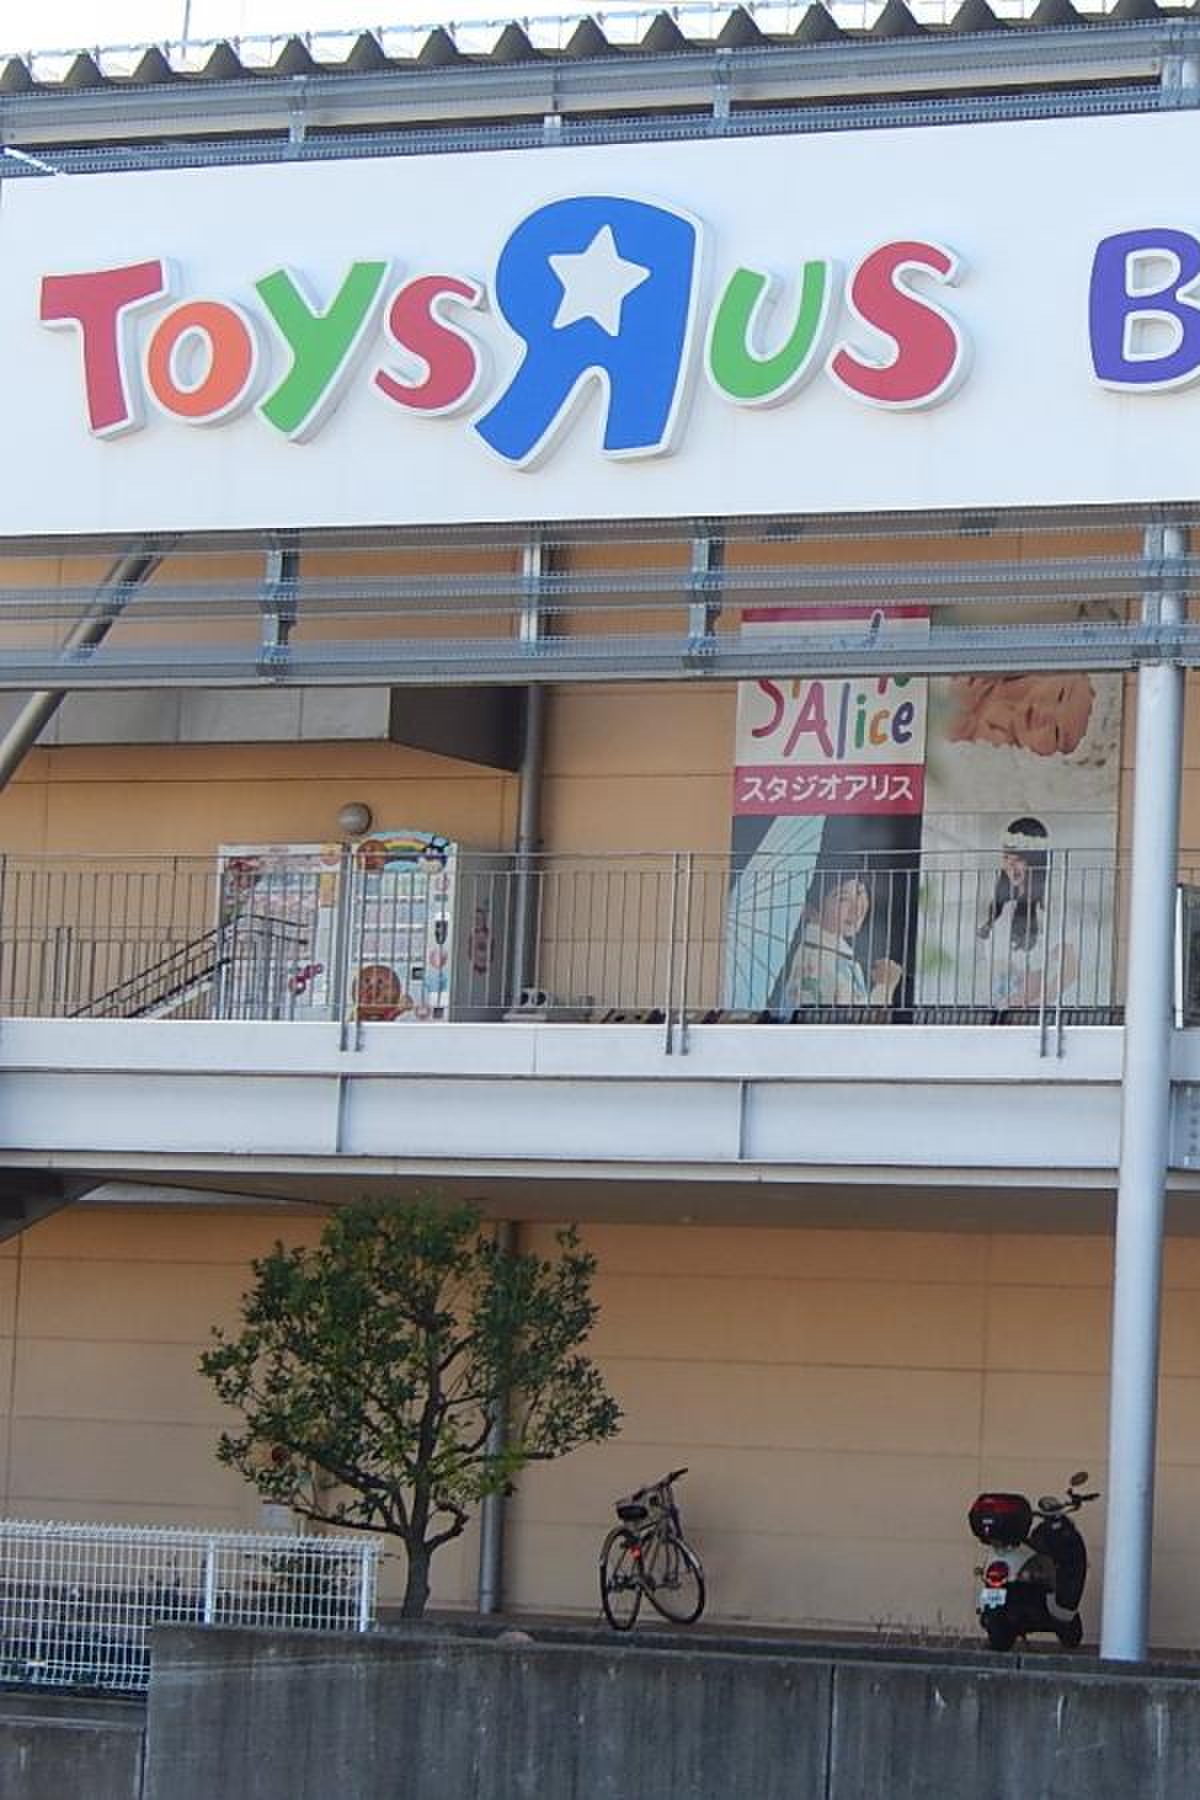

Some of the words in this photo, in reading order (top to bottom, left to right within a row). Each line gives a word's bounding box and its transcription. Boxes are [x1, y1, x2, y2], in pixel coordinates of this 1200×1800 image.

[783, 681, 915, 760] Alice
[742, 773, 913, 803] スタジオアリス
